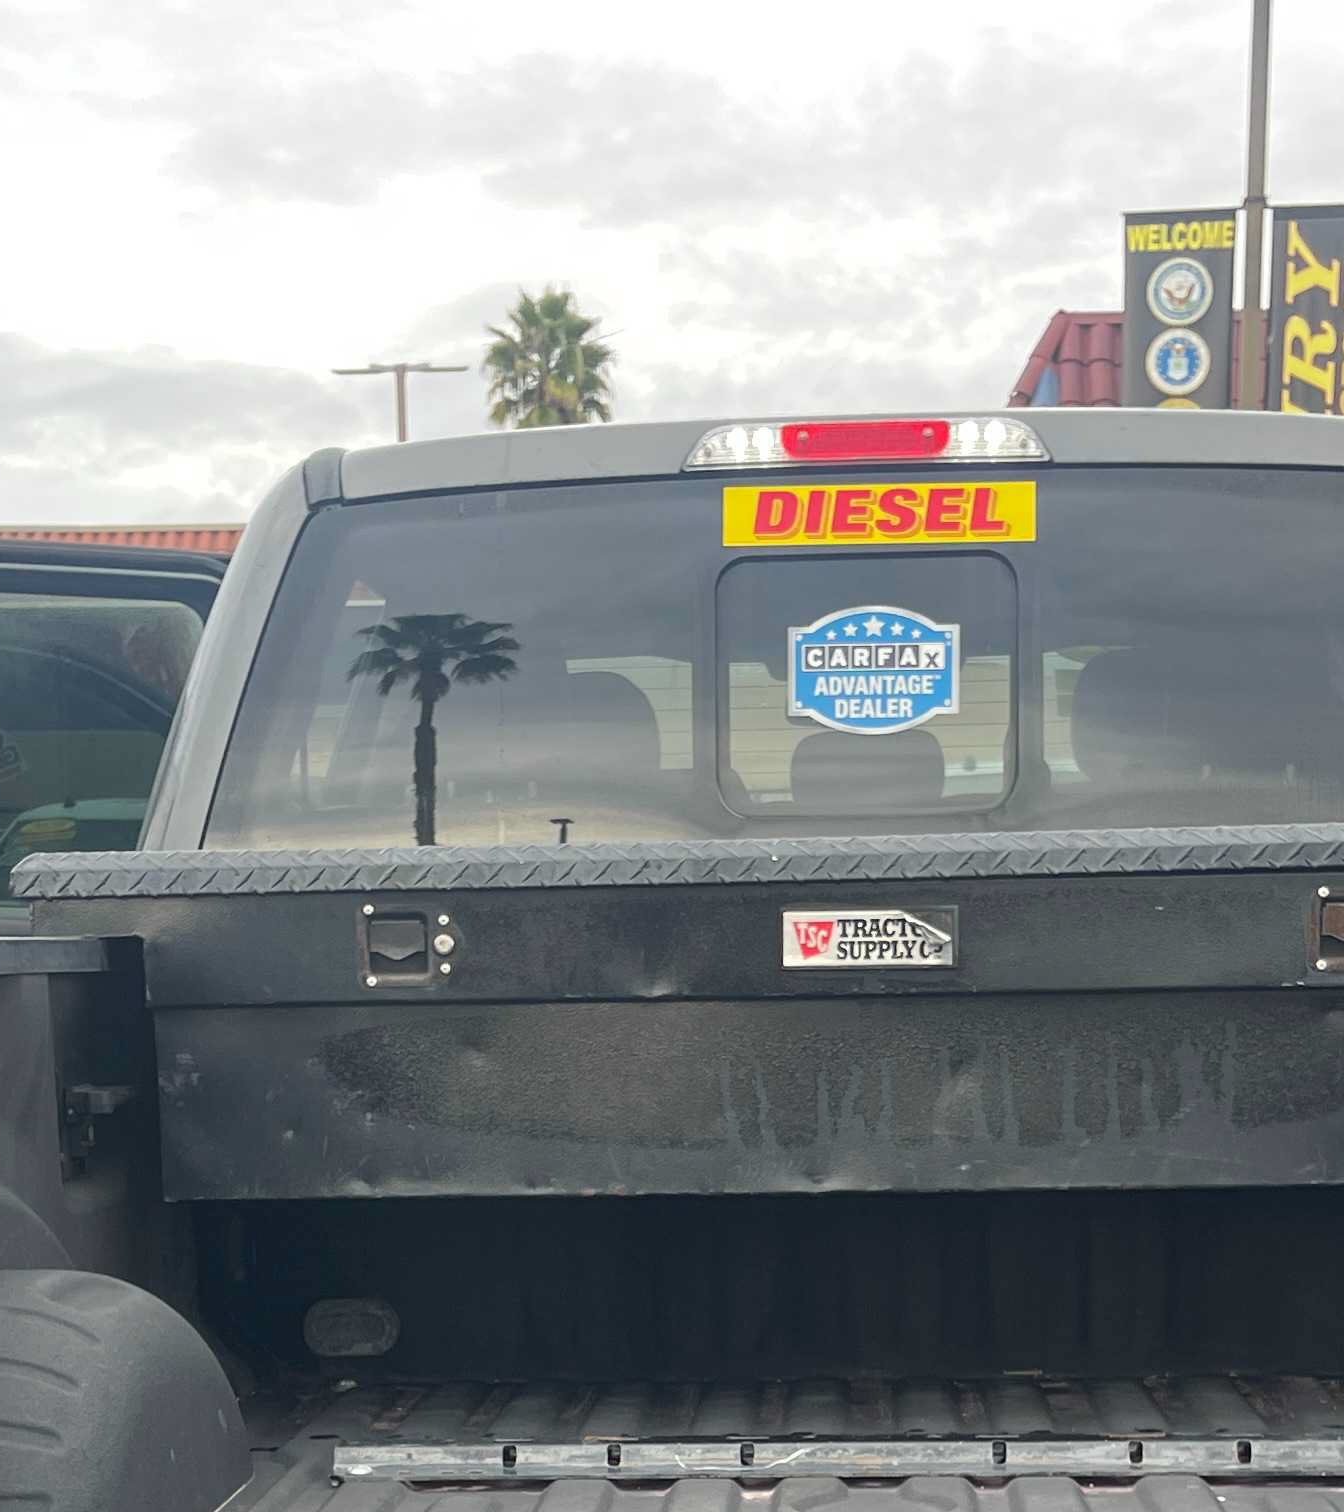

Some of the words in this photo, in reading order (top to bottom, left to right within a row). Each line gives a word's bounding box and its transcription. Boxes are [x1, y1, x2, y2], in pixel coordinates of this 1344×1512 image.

[1126, 220, 1235, 252] WELCOME
[753, 487, 1011, 538] DIESEL
[806, 646, 943, 668] CARFAX
[814, 675, 935, 697] ADVANTAGE
[834, 698, 913, 719] DEALER
[797, 922, 827, 953] TSC
[837, 940, 916, 959] SUPPLY
